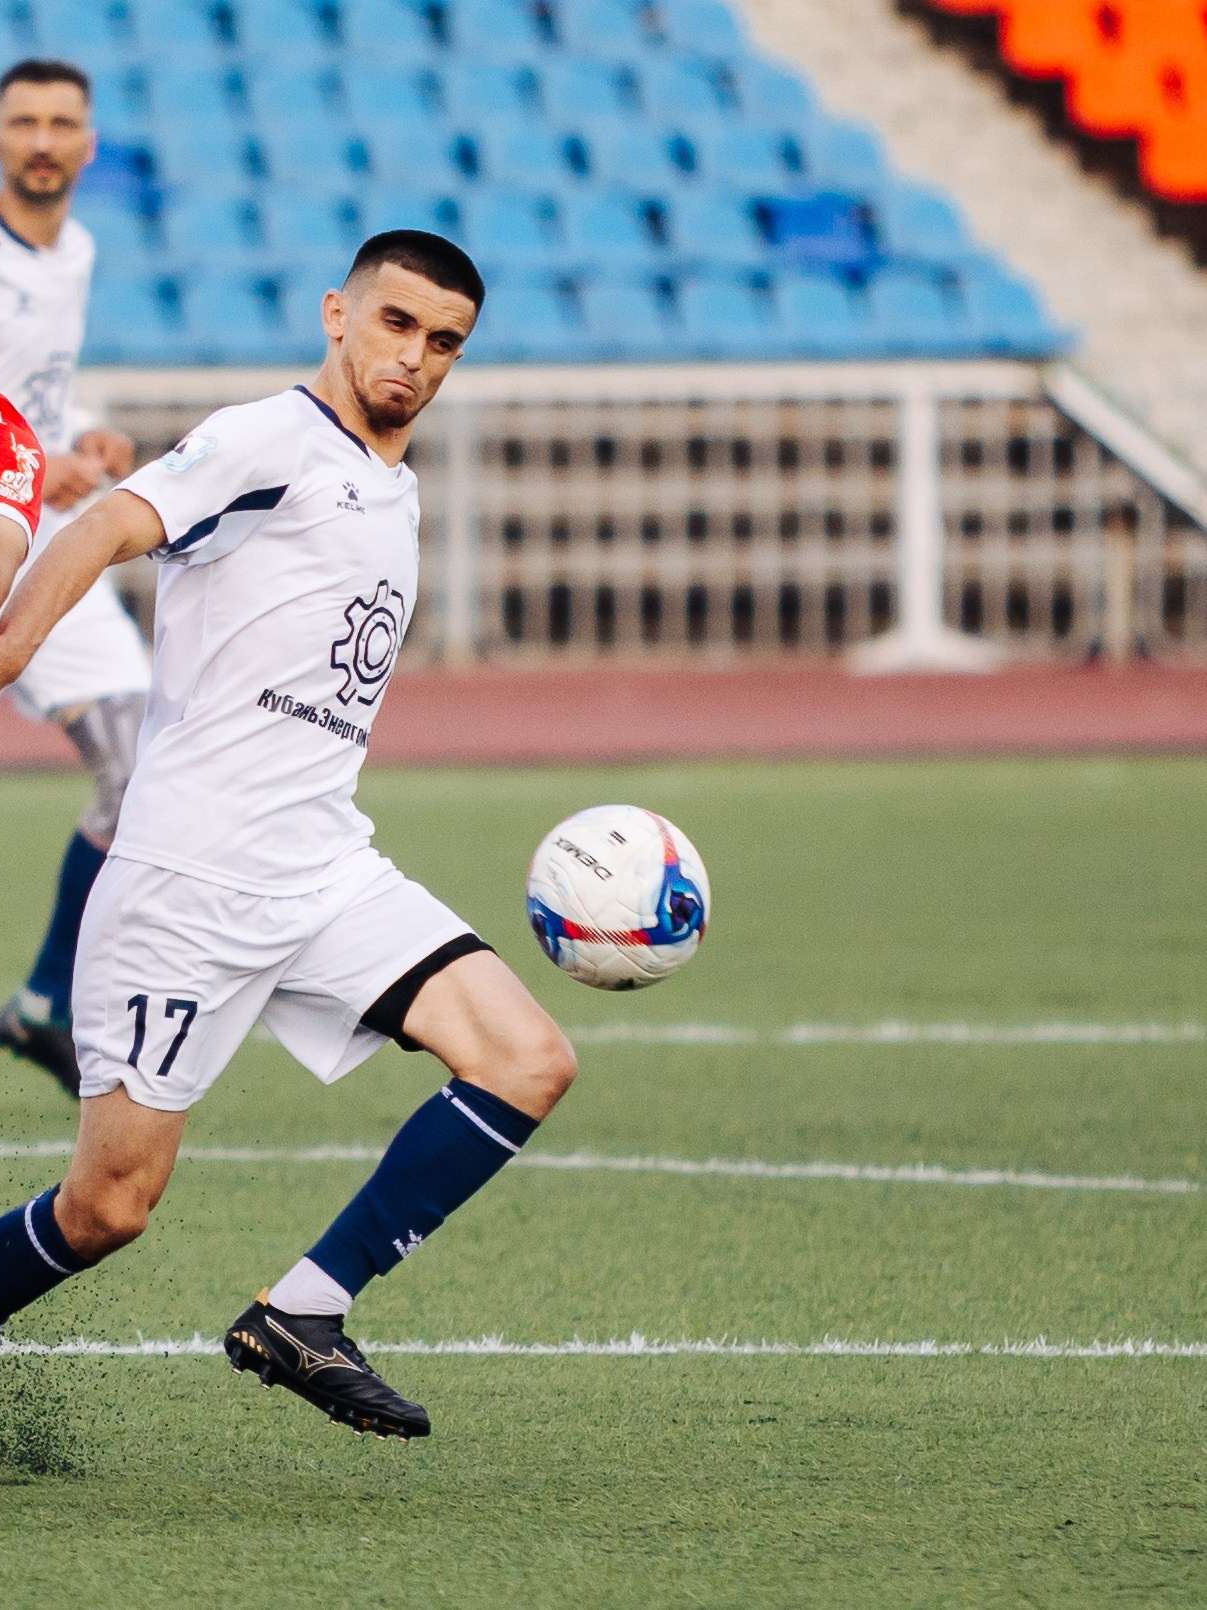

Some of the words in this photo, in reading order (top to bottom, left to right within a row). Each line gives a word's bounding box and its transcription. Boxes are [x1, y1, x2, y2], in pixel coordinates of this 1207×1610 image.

[336, 500, 366, 515] KELME
[553, 836, 615, 882] DEMIX
[127, 993, 198, 1077] 17
